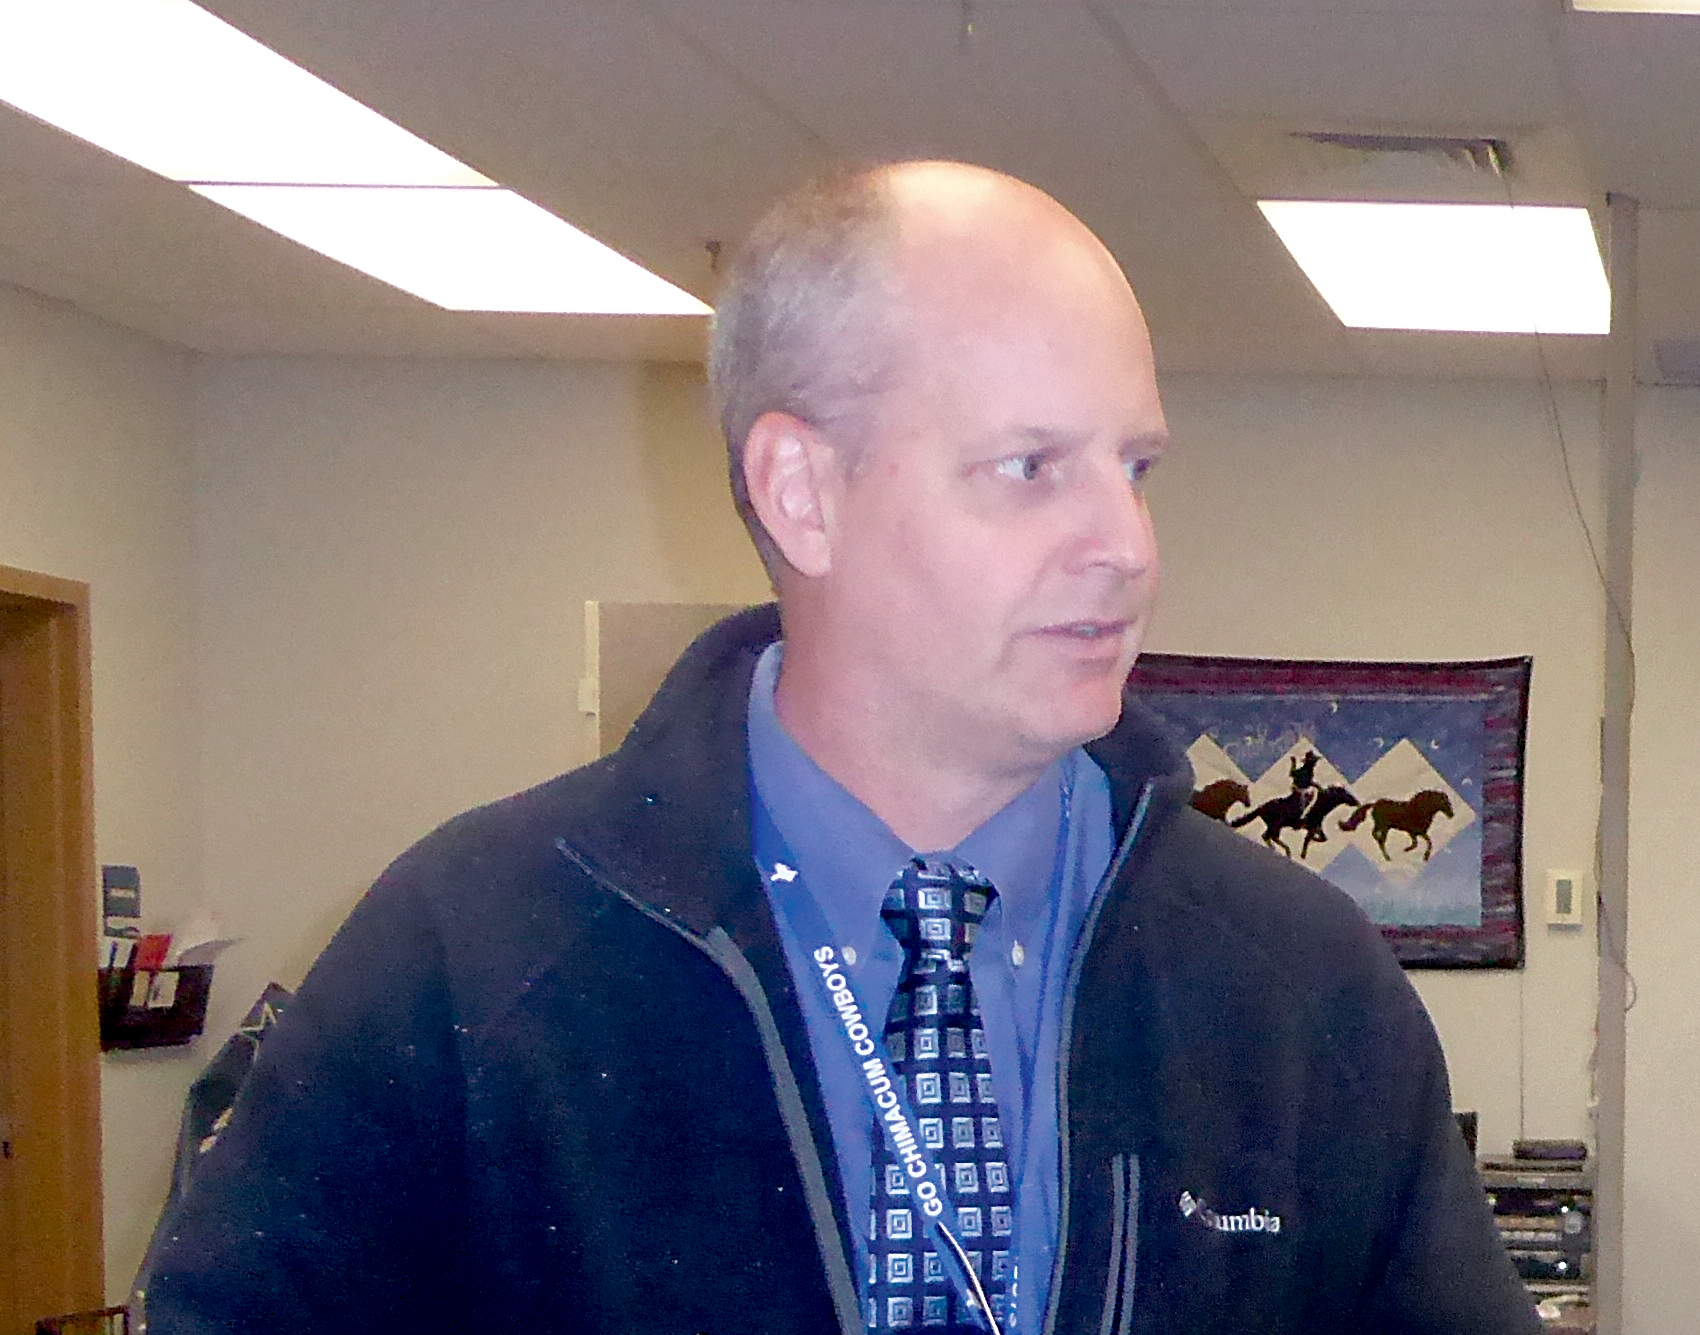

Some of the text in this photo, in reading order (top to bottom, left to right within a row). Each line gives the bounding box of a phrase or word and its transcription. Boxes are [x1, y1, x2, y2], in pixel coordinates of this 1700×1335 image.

[814, 946, 942, 1216] GO CHIMACUM COWBOYS
[1199, 1203, 1280, 1233] umbia
